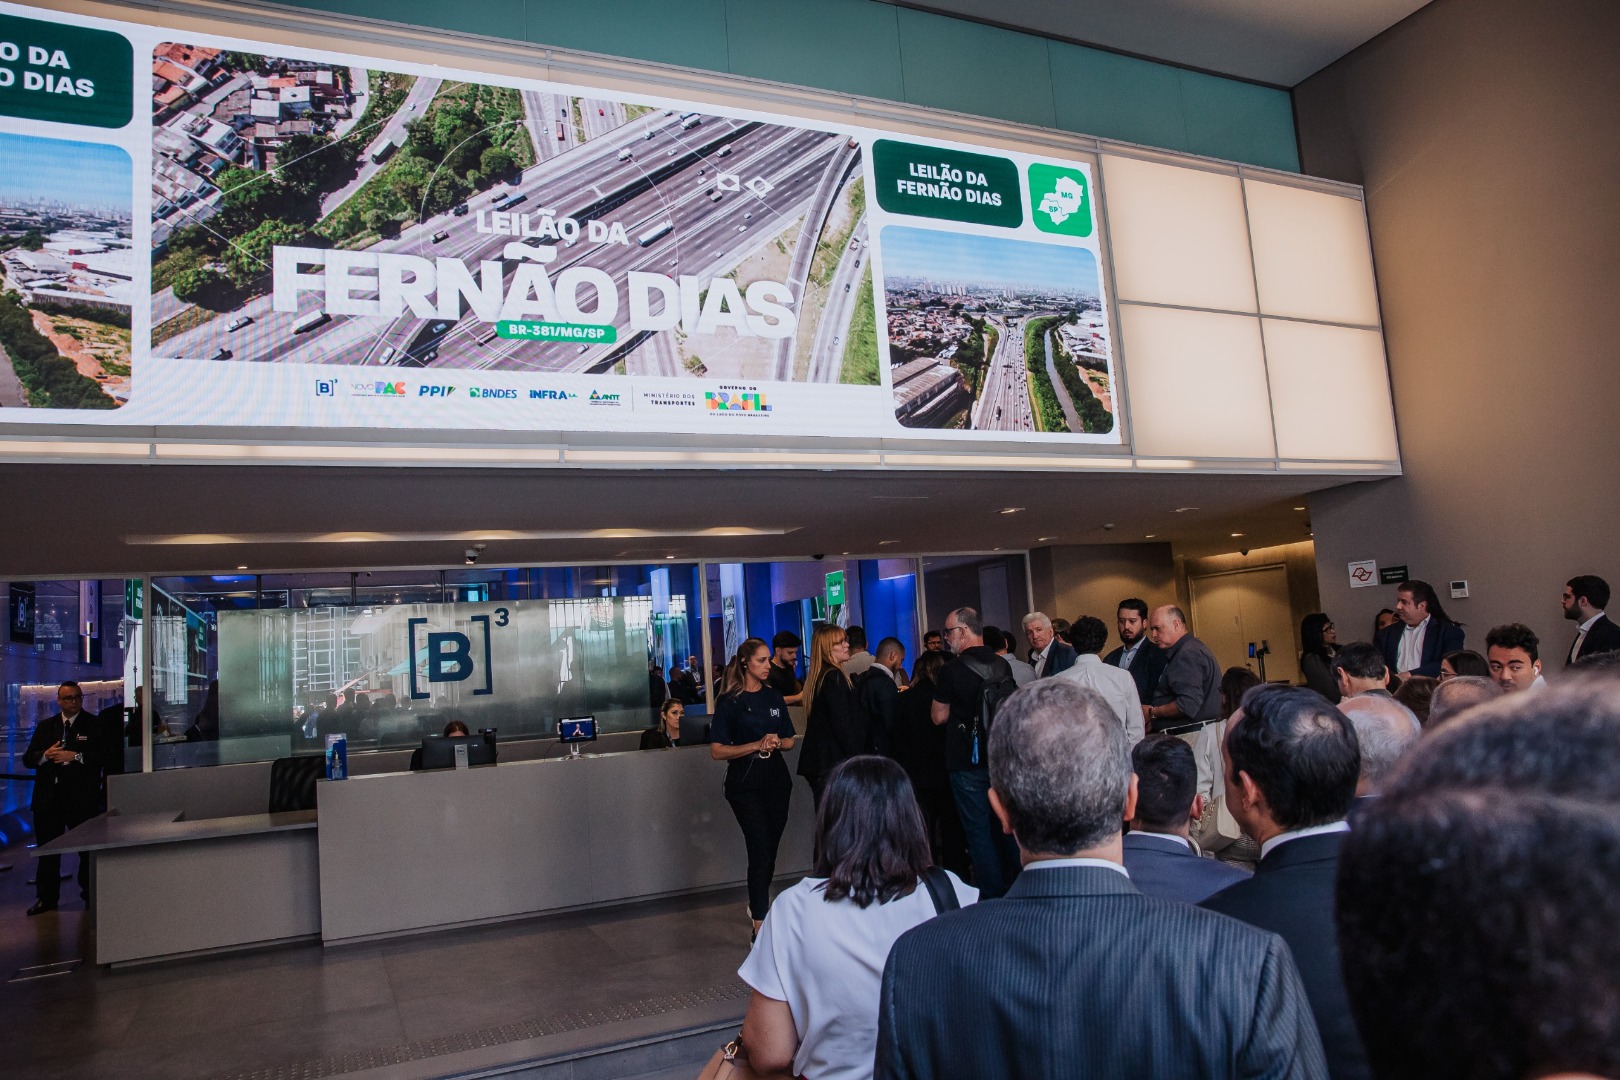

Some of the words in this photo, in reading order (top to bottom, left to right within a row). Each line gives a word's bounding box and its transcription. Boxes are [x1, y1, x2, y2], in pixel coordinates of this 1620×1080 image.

[28, 46, 71, 69] DA
[24, 71, 95, 97] DIAS
[909, 162, 963, 183] LEILÃO
[965, 171, 989, 187] DA
[897, 179, 962, 201] FERNÃO
[965, 189, 1002, 206] DIAS
[1060, 191, 1074, 200] MG
[1048, 205, 1059, 213] SP
[476, 208, 580, 242] LEILÃO
[588, 219, 630, 246] DA
[272, 241, 618, 324] FERNÃO
[627, 270, 796, 339] DIAS
[508, 323, 606, 339] BR-381/MG/SP
[375, 381, 406, 395] PAC
[419, 385, 446, 397] PPI
[482, 388, 517, 399] BNDES
[529, 389, 568, 400] INFRA
[704, 391, 772, 411] BRASIL
